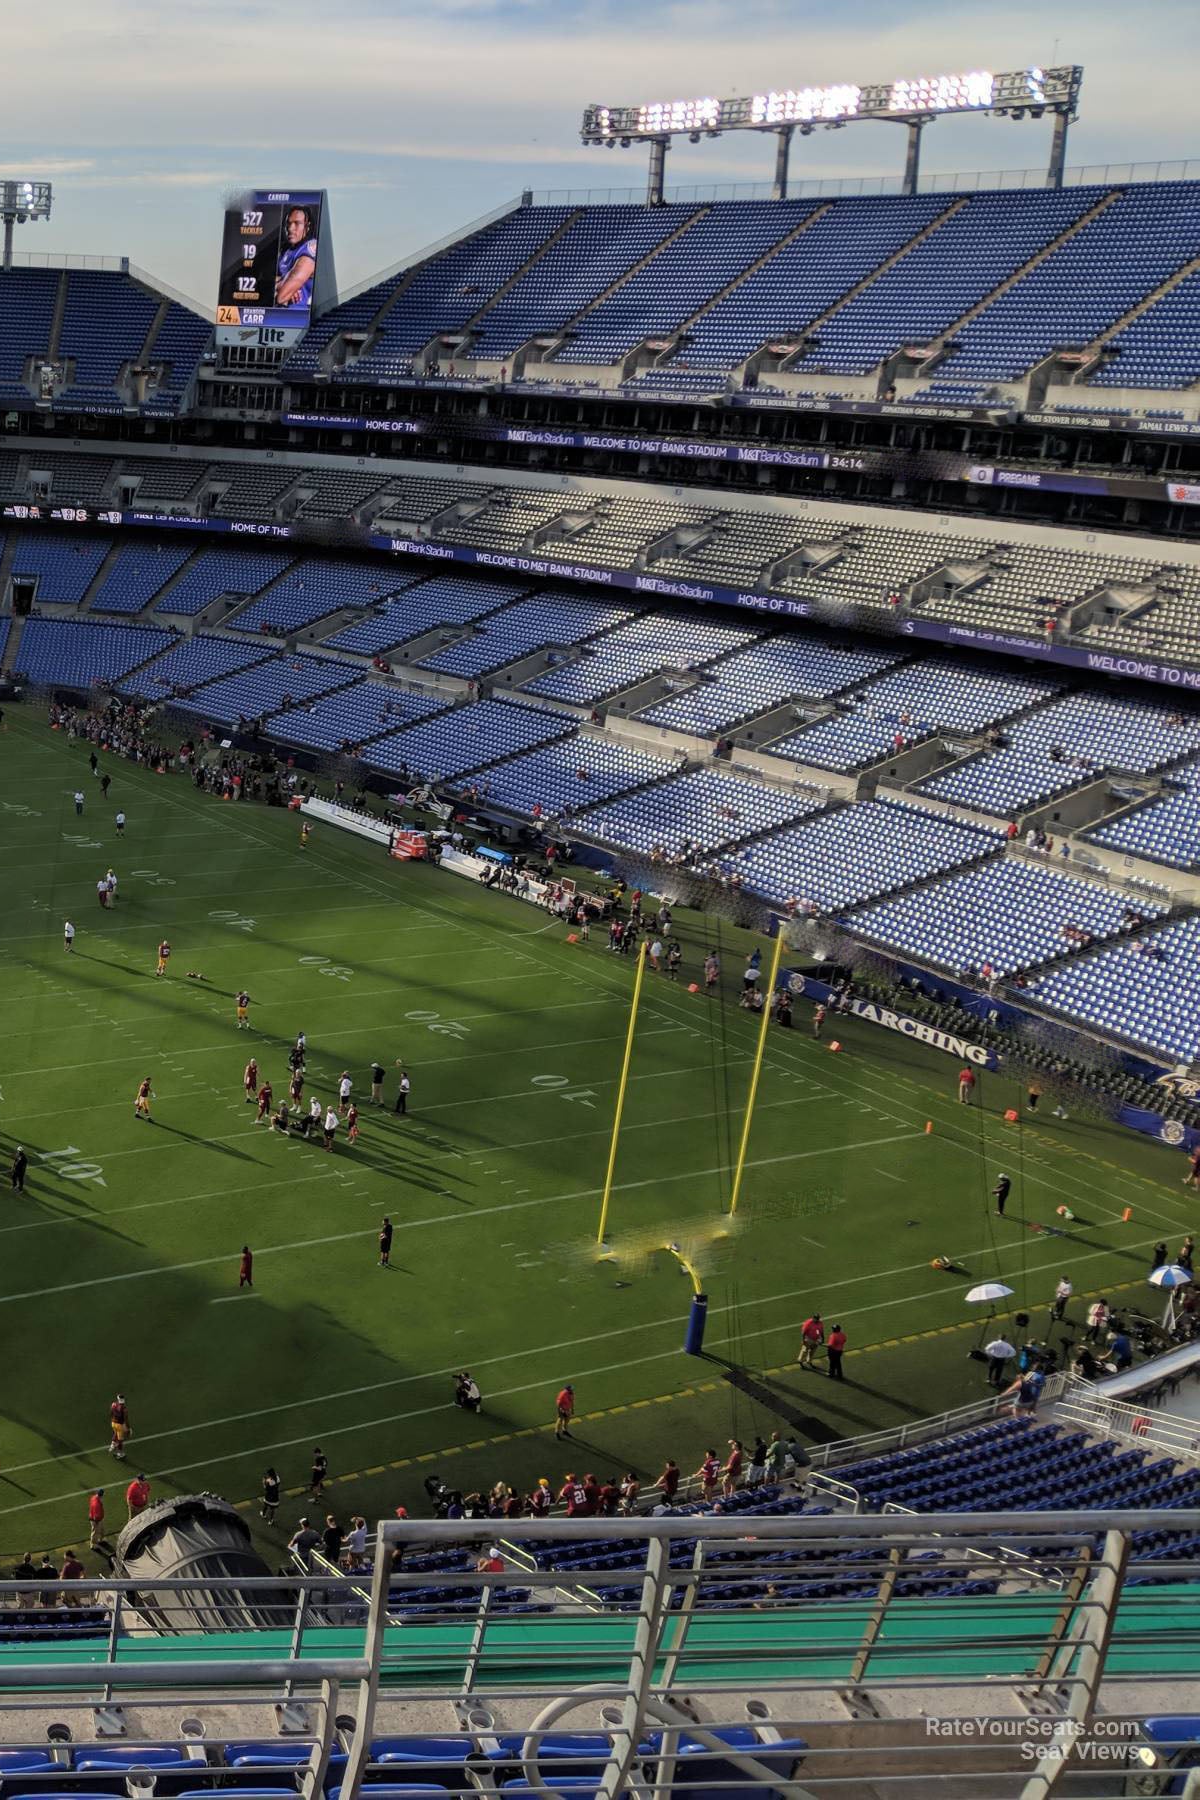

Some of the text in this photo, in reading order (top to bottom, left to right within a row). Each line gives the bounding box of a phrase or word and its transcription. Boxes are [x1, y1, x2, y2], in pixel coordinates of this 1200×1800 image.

[243, 212, 262, 226] 527
[243, 244, 256, 259] 19
[238, 277, 256, 291] 122
[219, 308, 232, 322] 24
[243, 315, 264, 324] CARR
[258, 327, 285, 346] Lite
[880, 405, 913, 414] JONATHAN
[914, 407, 937, 416] OGDEN
[366, 420, 416, 432] HOME OF TH
[1023, 414, 1042, 423] MATT
[1044, 415, 1070, 425] STOVER
[1138, 422, 1163, 431] JAMAL
[1165, 424, 1188, 433] LEWIS
[507, 430, 574, 445] M&T Bank Stadium
[583, 436, 726, 457] WELCOME TO M&T BANK STADIUM
[738, 448, 818, 466] M&T Bank Stadium
[831, 456, 862, 470] 34:14
[977, 469, 986, 481] 0
[999, 472, 1040, 486] PREGAME
[231, 522, 289, 537] HOME OF THE
[391, 539, 454, 559] M&T Bank Stadium
[476, 552, 612, 583] WELCOME TO M&T BANK STADIUM
[636, 576, 714, 600] M&T Bank Stadium
[737, 593, 807, 615] HOME OF THE
[1088, 653, 1158, 679] WELCOME
[1160, 667, 1180, 682] TO
[131, 870, 176, 885] 50
[208, 910, 258, 926] 40
[298, 956, 354, 976] 30
[404, 1010, 471, 1033] 20
[530, 1074, 598, 1101] 10
[34, 1145, 103, 1179] 10
[573, 1489, 587, 1504] 21
